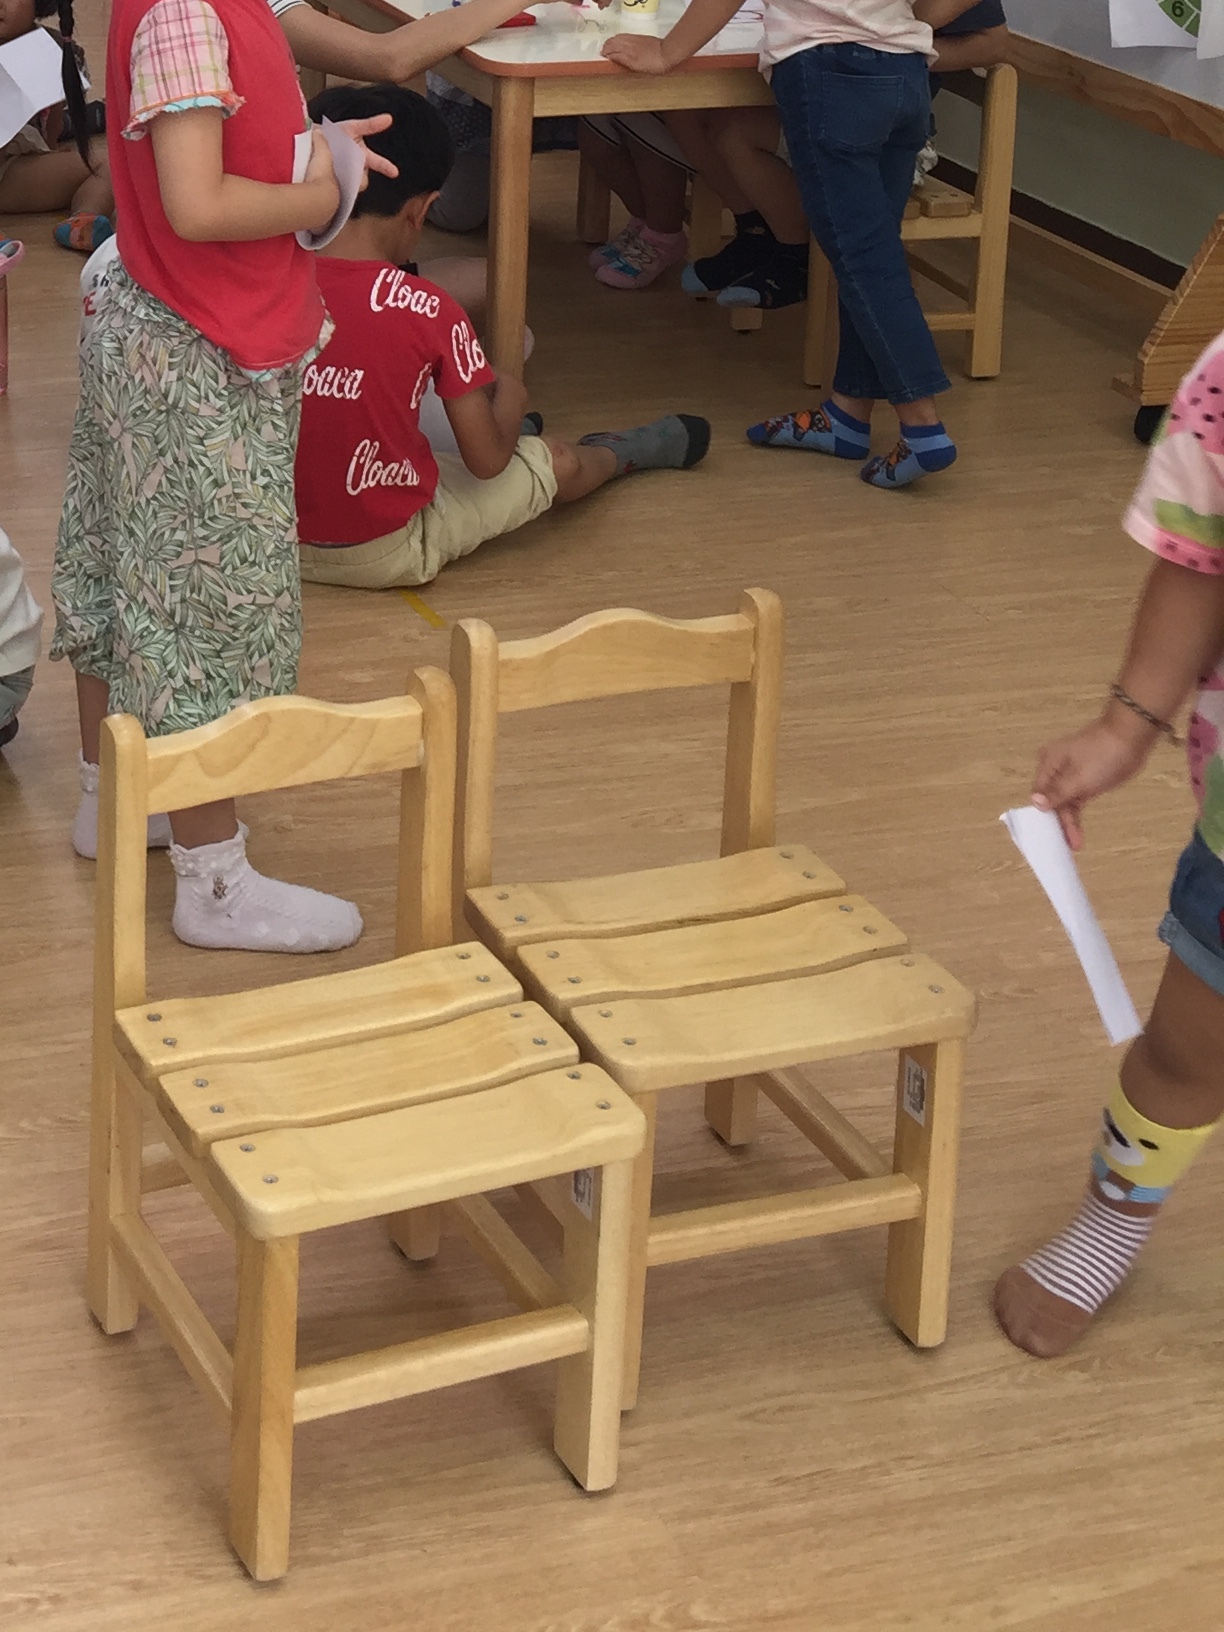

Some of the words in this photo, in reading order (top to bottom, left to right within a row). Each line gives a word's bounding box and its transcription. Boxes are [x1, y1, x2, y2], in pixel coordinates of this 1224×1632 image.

[1171, 0, 1185, 18] 6
[450, 320, 485, 384] Clo
[302, 364, 365, 400] oaca
[345, 438, 421, 496] Cloaca
